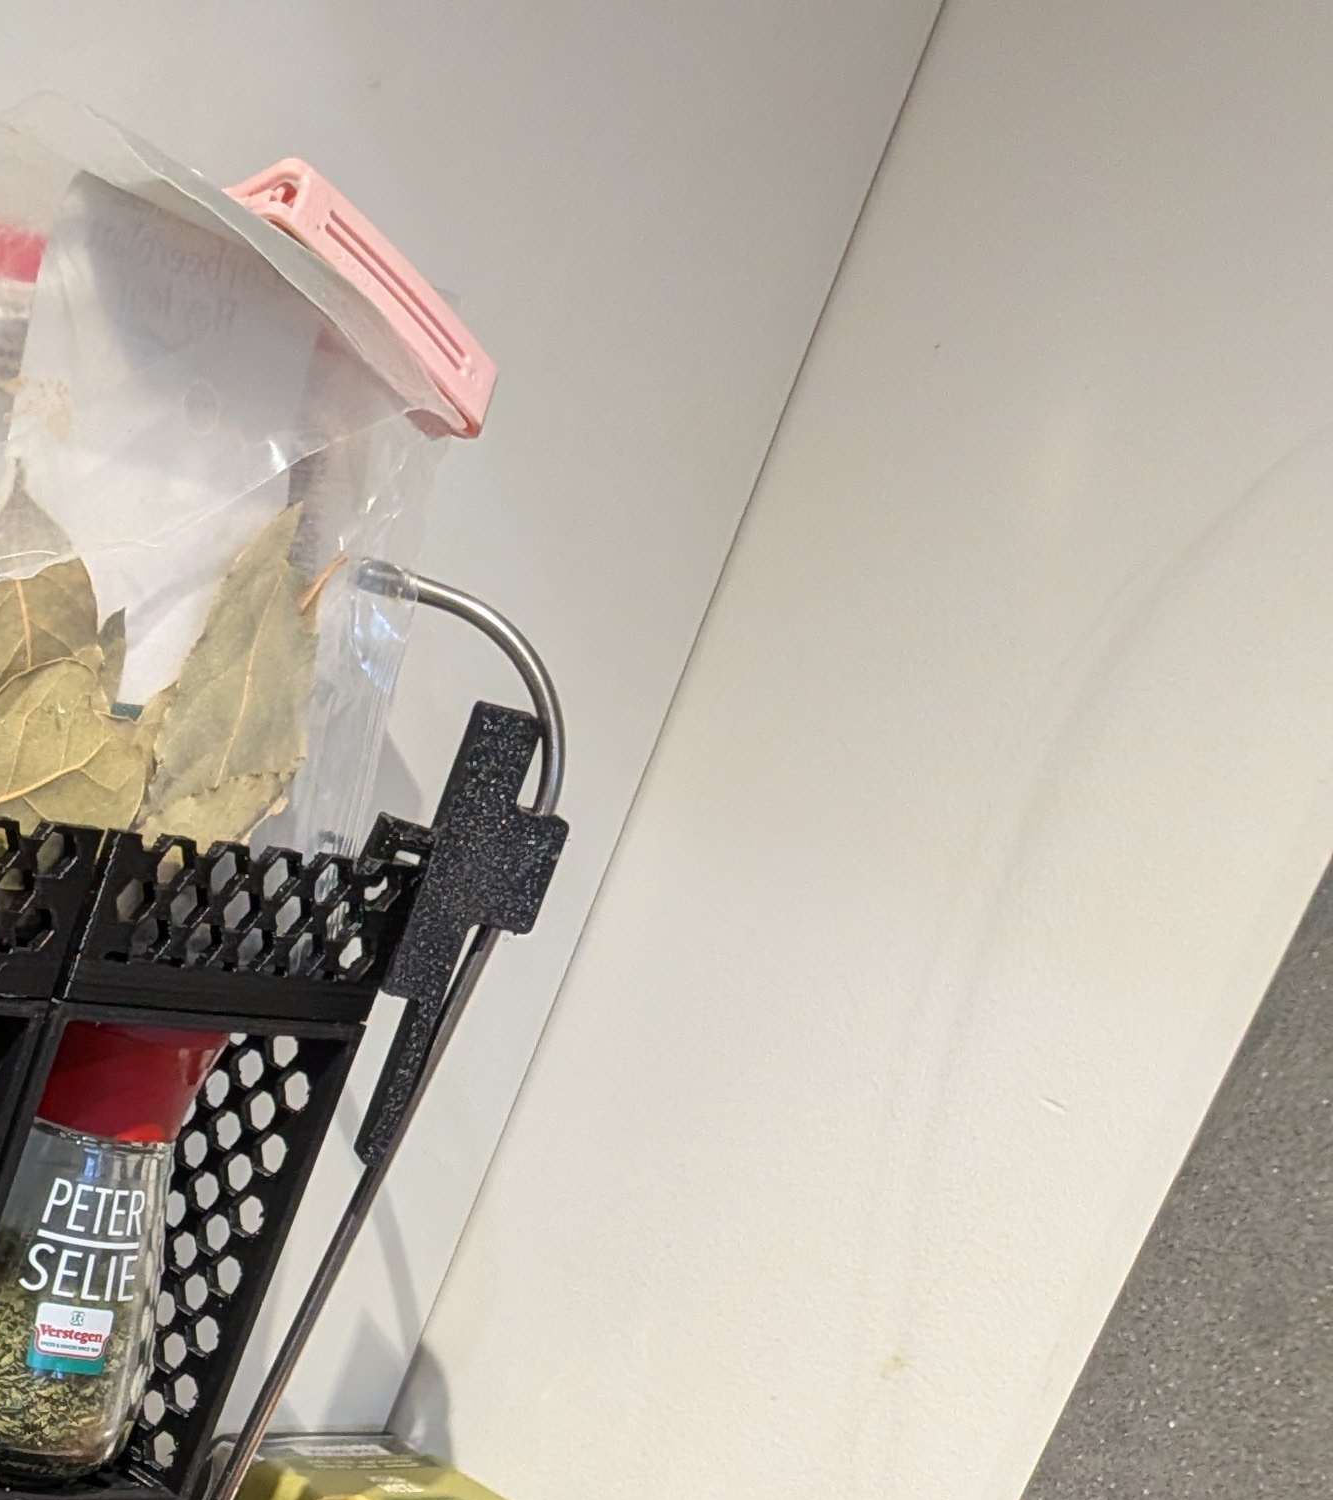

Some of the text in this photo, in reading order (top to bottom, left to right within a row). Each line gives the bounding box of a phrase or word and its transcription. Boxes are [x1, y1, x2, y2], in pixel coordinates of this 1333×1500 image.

[41, 1177, 146, 1237] PETER
[18, 1243, 139, 1303] SELIE
[39, 1322, 103, 1345] Verstegen
